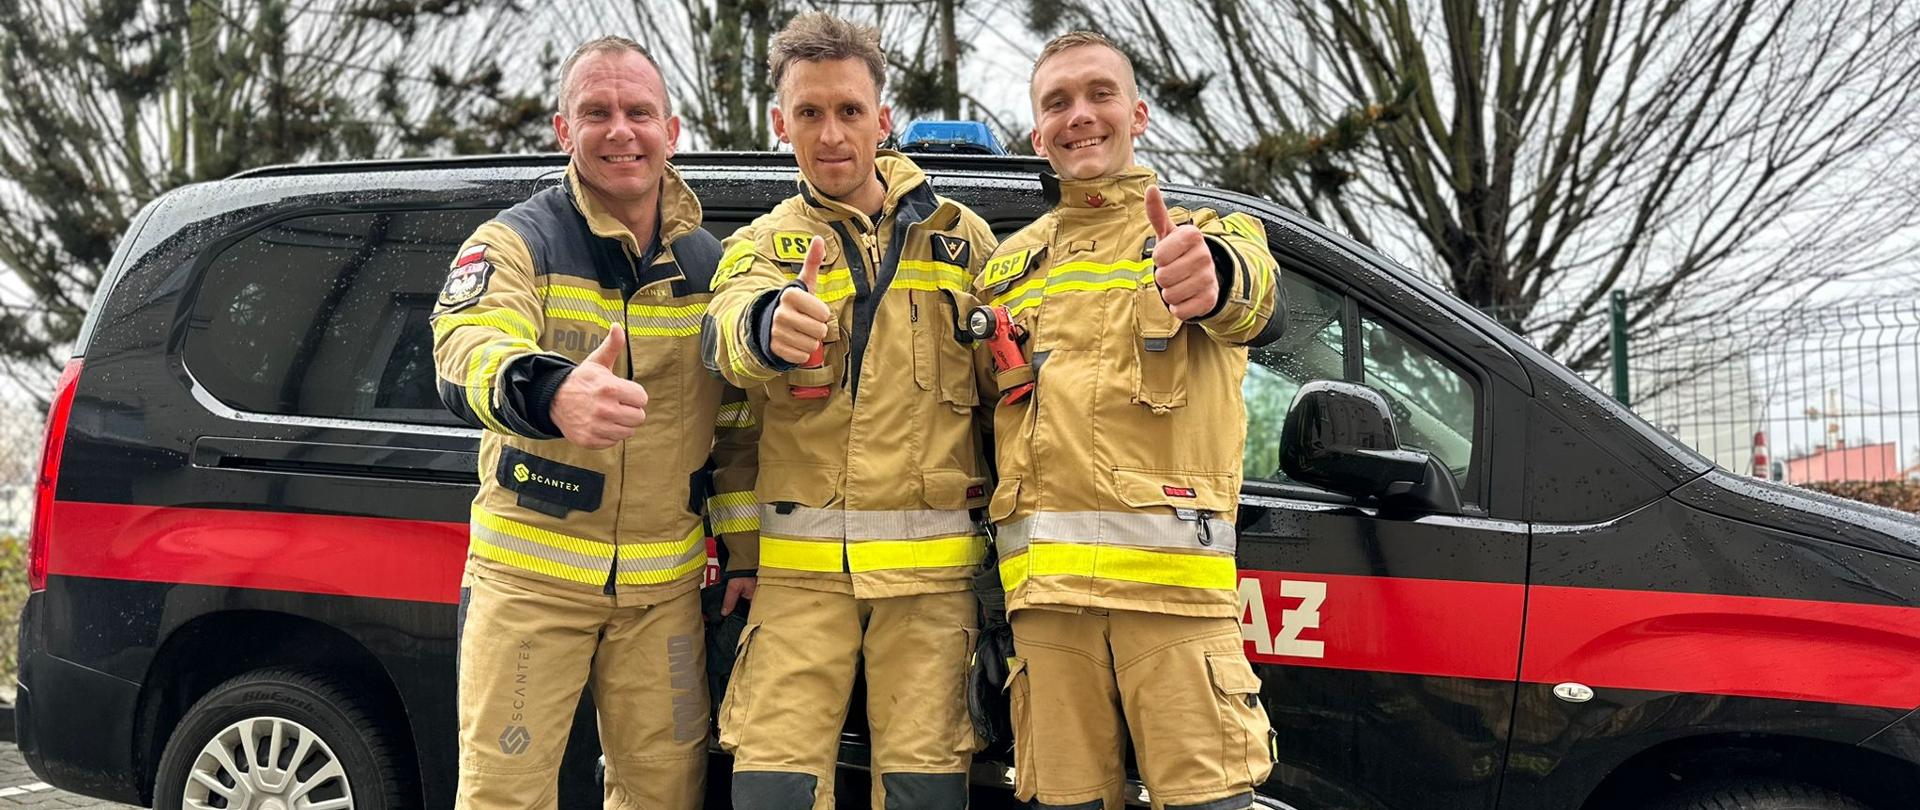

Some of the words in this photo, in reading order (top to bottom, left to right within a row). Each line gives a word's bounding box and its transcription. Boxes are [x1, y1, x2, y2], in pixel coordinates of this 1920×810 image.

[989, 255, 1021, 280] PSP
[552, 328, 604, 352] POLA
[530, 473, 580, 493] SCANTEX
[511, 638, 533, 722] SCANTEX
